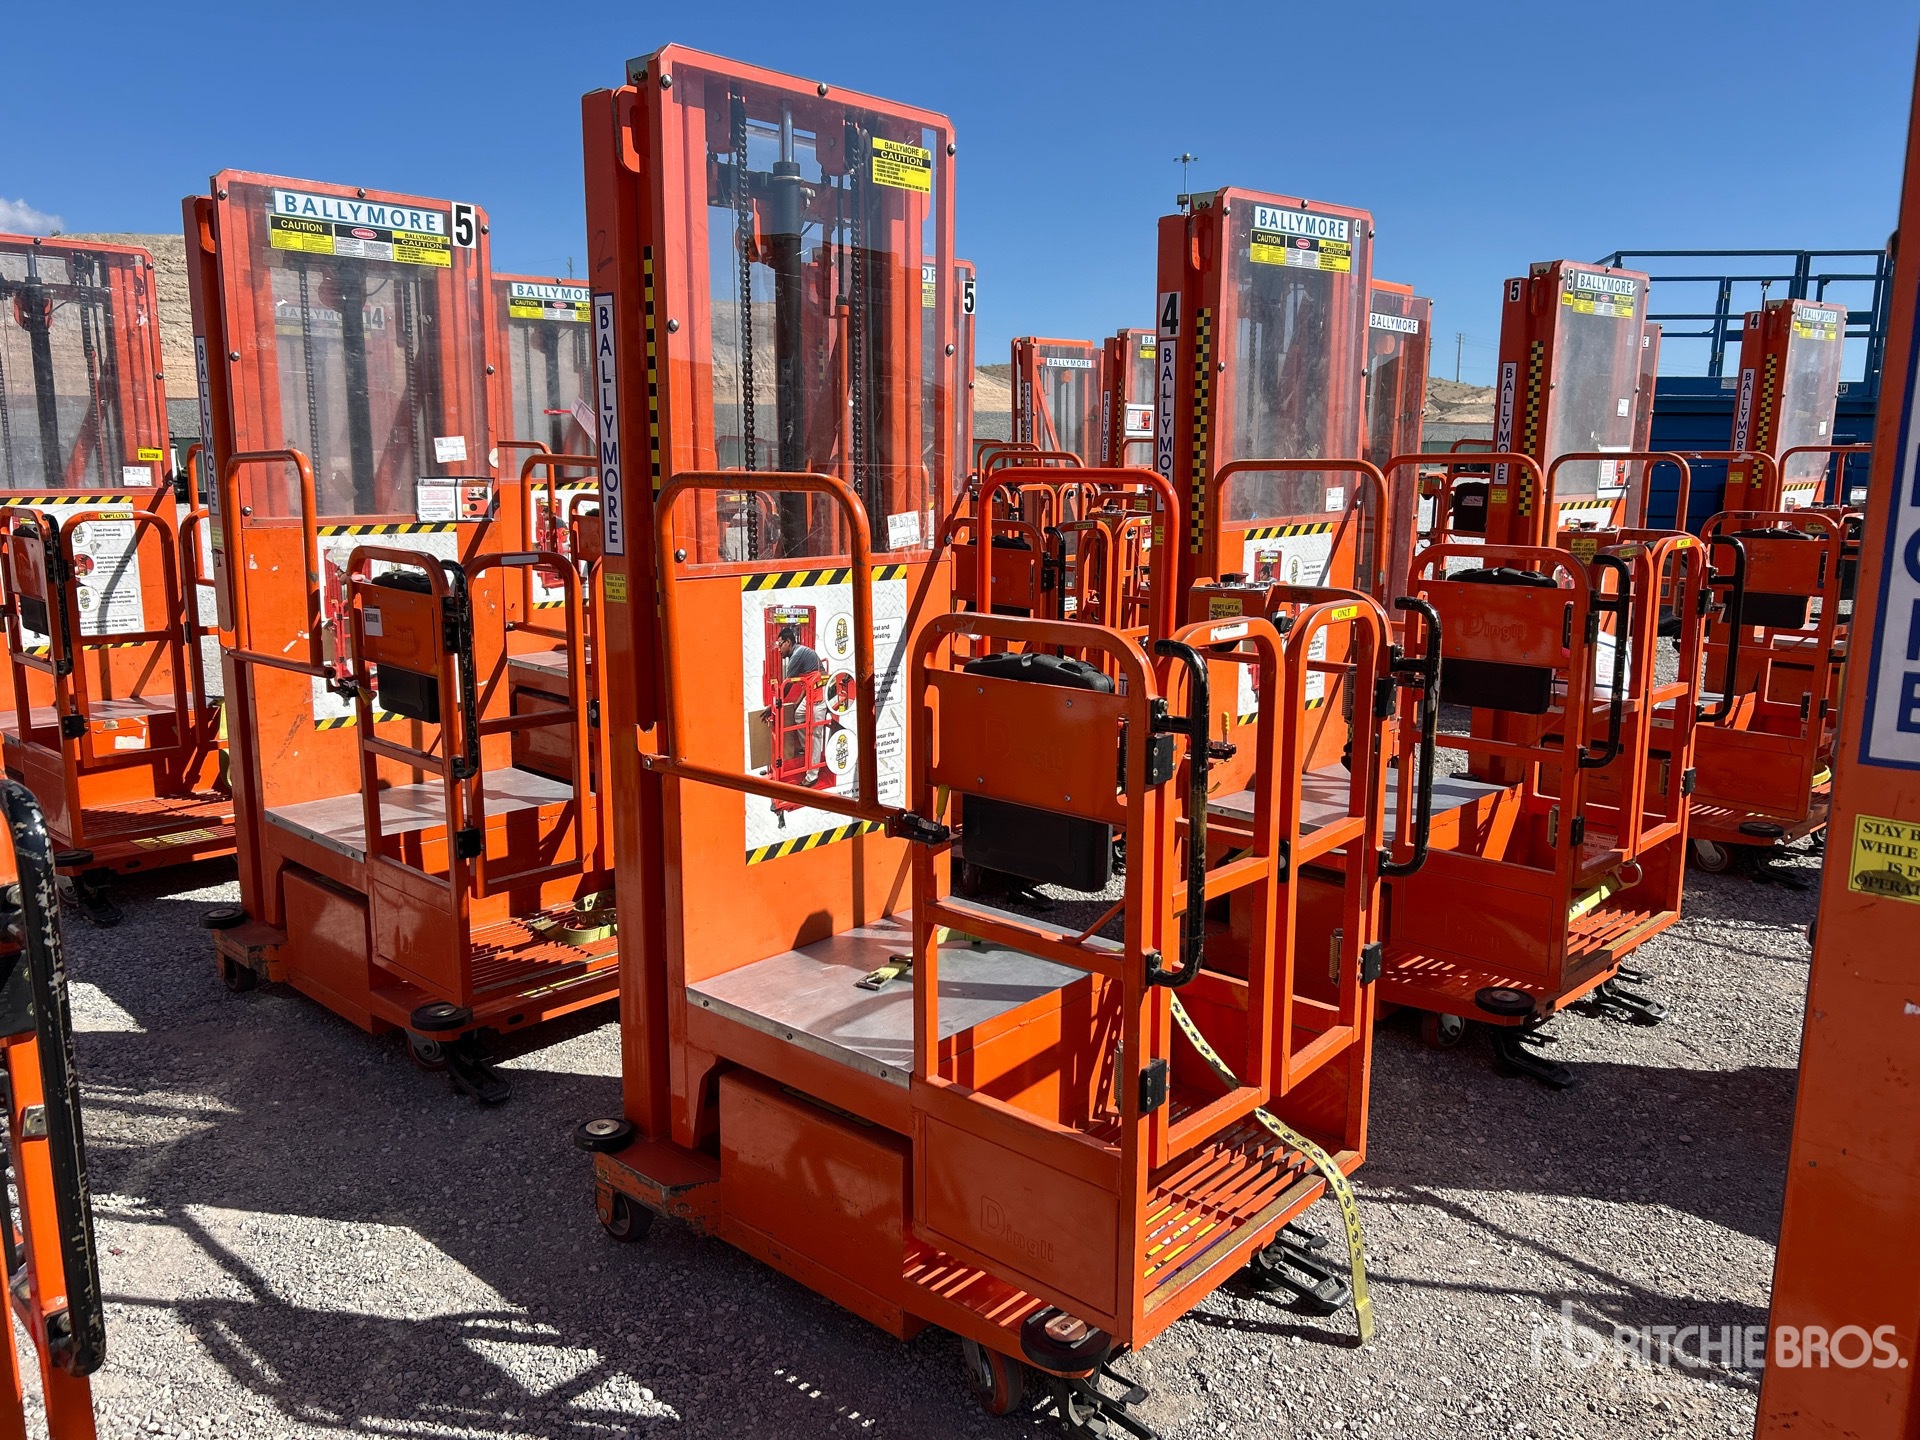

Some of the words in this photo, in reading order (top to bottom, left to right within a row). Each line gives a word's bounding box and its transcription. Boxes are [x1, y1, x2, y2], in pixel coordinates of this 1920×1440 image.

[884, 142, 919, 156] BALLYMORE
[881, 151, 922, 166] CAUTION
[285, 194, 436, 231] BALLYMORE
[280, 220, 322, 232] CAUTION
[456, 204, 473, 246] 5
[1260, 209, 1344, 238] BALLYMORE
[401, 240, 442, 249] CAUTION
[404, 233, 438, 242] BALLYMORE
[1257, 234, 1280, 244] CAUTION
[1324, 248, 1346, 256] CAUTION
[1568, 270, 1573, 290] 5
[1580, 275, 1632, 294] BALLYMORE
[517, 284, 590, 300] BALLYMOR
[964, 283, 974, 313] 5
[1511, 282, 1520, 300] 5
[1162, 293, 1178, 334] 4
[1750, 314, 1758, 328] 4
[1372, 314, 1416, 332] BALLYMORE
[1048, 359, 1090, 368] BALLYMORE
[1736, 372, 1752, 452] BALLYMOR
[198, 344, 217, 506] BALLYMORE
[600, 306, 618, 544] BALLYMORE
[1158, 348, 1174, 504] BALLYMOR
[880, 738, 899, 746] attached
[1863, 822, 1906, 838] STAY
[1860, 838, 1918, 859] WHILE
[1887, 861, 1902, 874] IS
[980, 1195, 1054, 1263] Dingli
